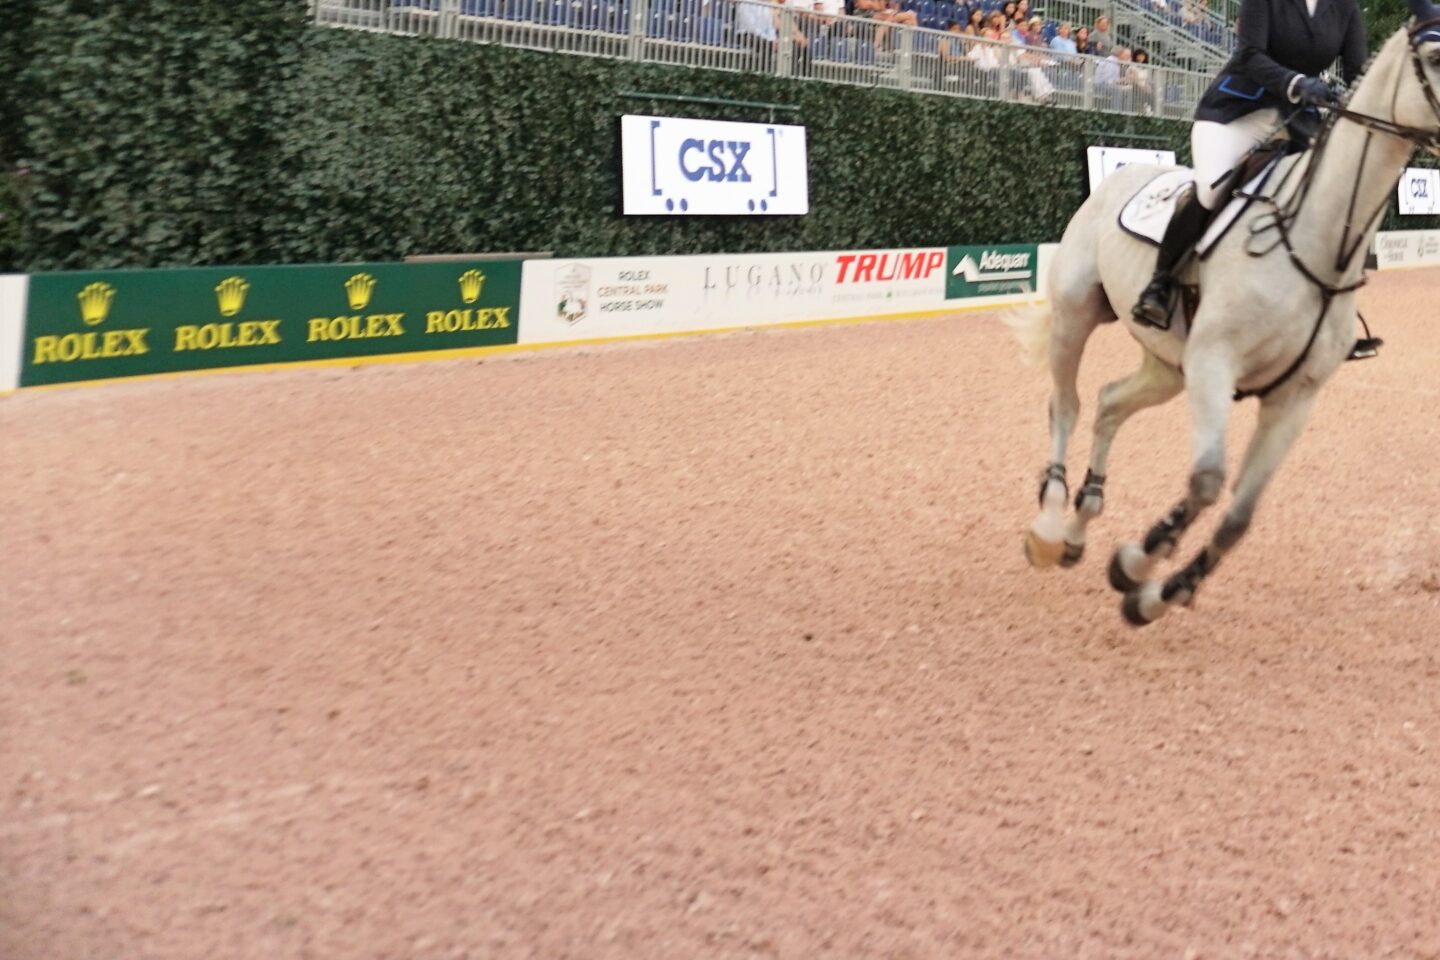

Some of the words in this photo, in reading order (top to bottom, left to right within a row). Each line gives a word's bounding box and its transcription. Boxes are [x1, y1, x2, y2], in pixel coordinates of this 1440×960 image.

[678, 137, 752, 183] CSX
[618, 270, 651, 282] ROLEX
[703, 262, 825, 290] LUGANO
[836, 251, 945, 284] TRUMP
[597, 285, 642, 298] CENTRAL
[644, 283, 670, 295] PARK
[425, 307, 512, 334] ROLEX
[599, 300, 633, 313] HORSE
[635, 299, 665, 311] SHOW
[173, 319, 282, 353] ROLEX
[306, 312, 406, 343] ROLEX
[32, 328, 151, 365] ROLEX
